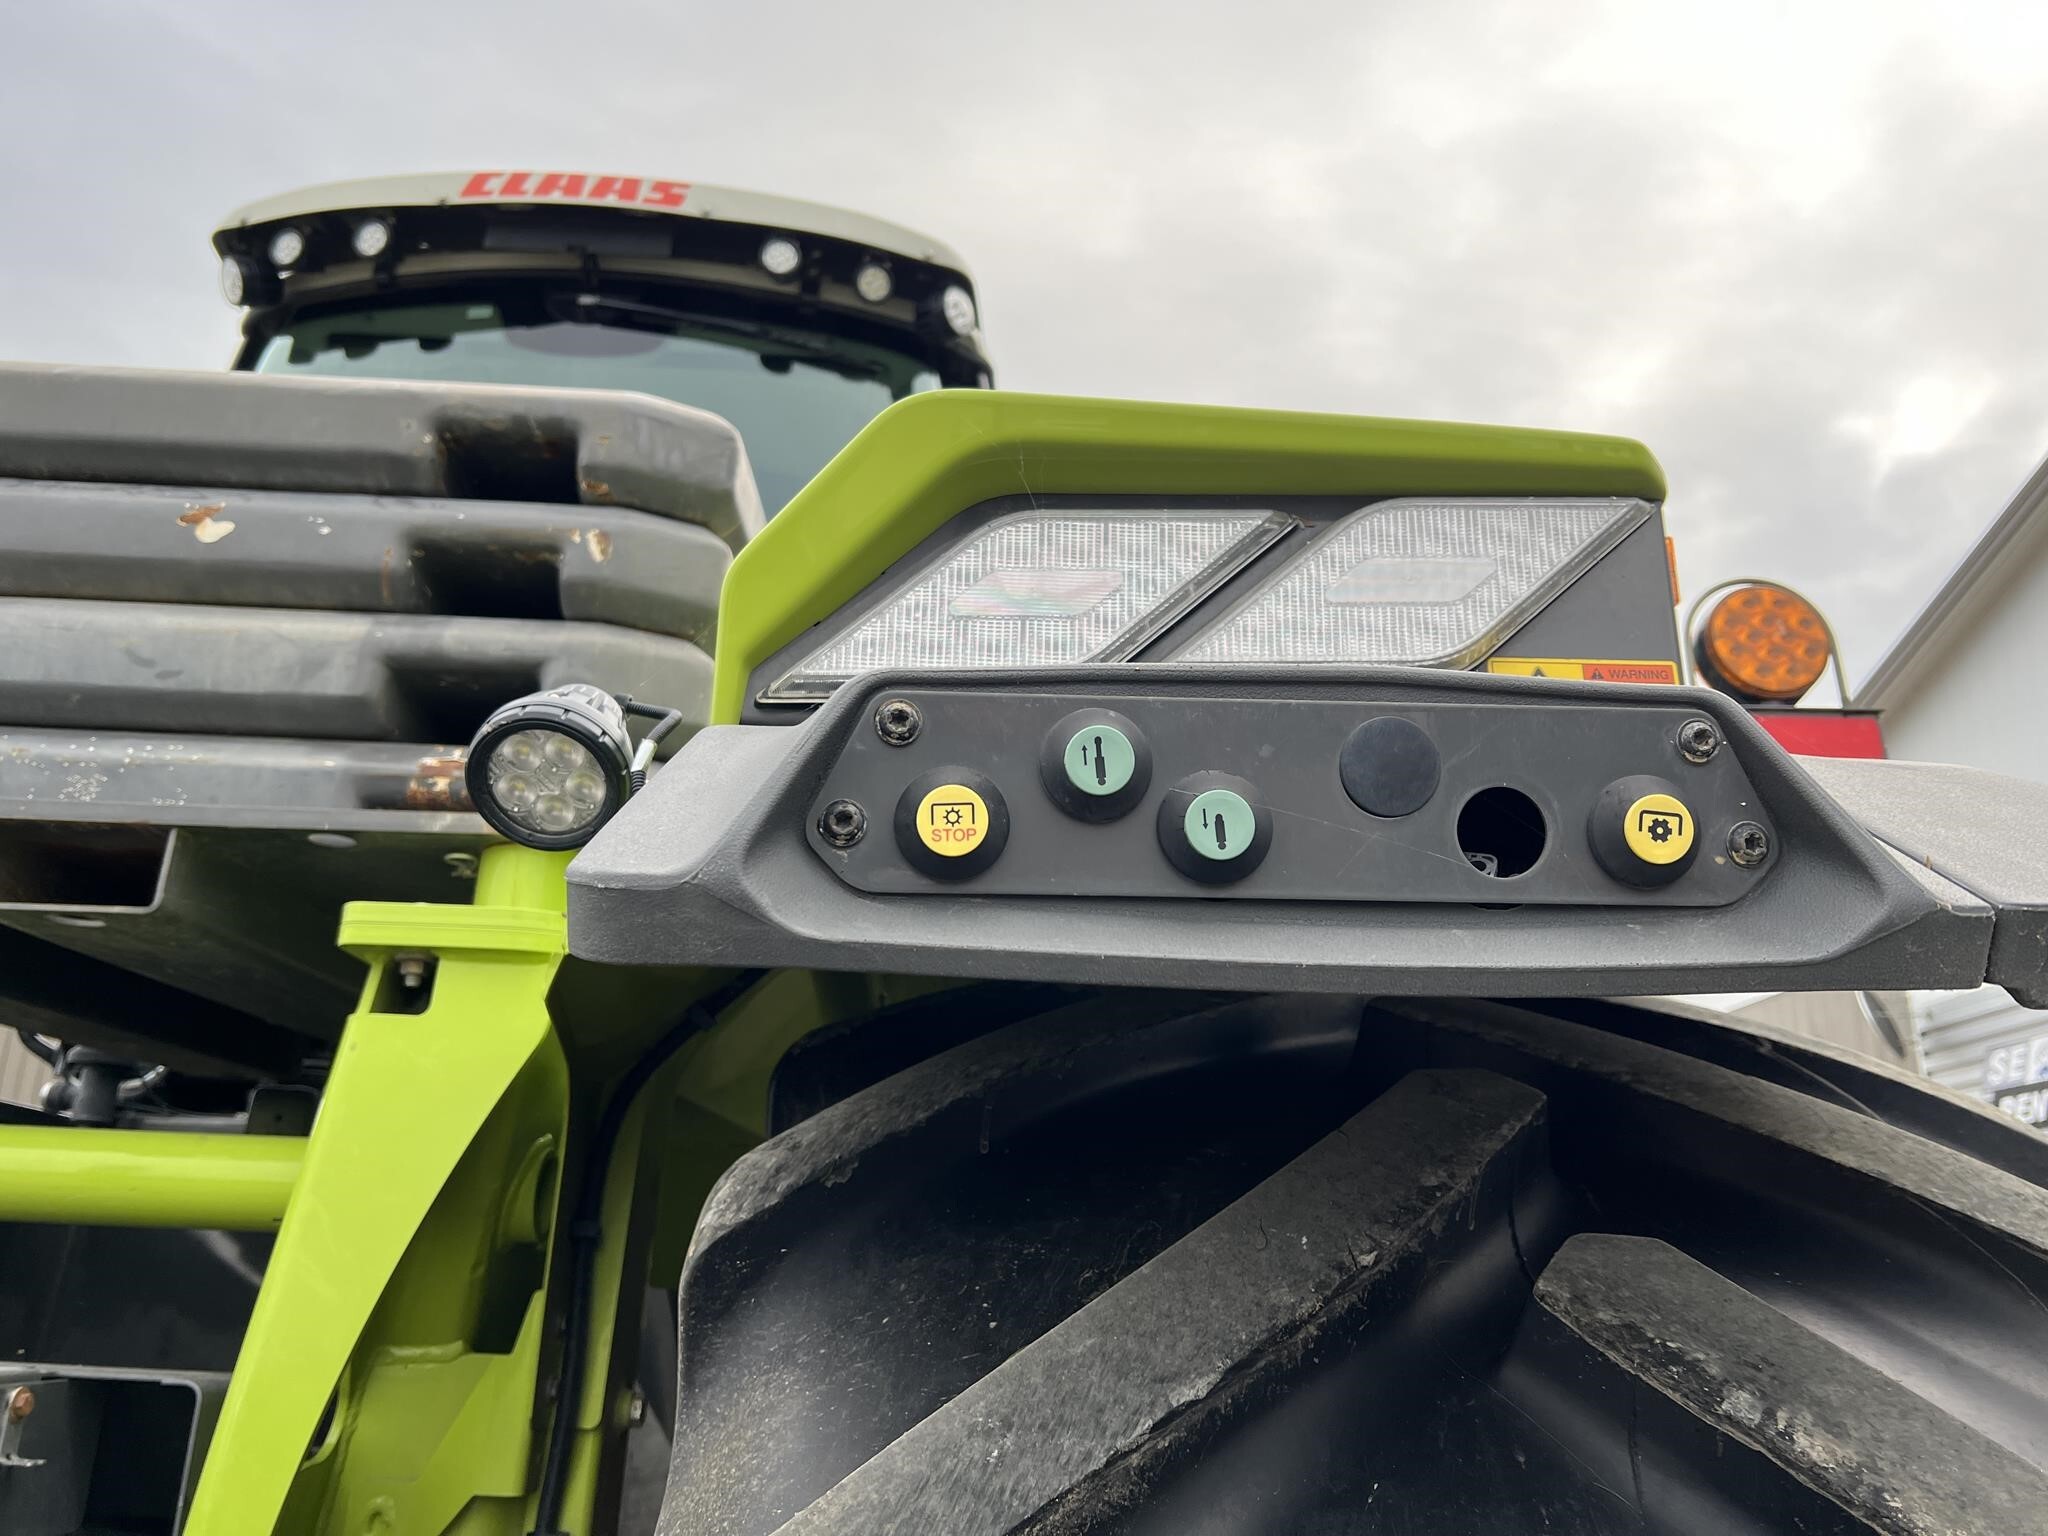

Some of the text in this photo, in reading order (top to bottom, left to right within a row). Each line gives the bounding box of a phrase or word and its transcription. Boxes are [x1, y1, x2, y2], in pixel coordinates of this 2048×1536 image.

[460, 172, 691, 208] CLAAS
[1608, 669, 1670, 680] WARNING
[931, 828, 977, 842] STOP
